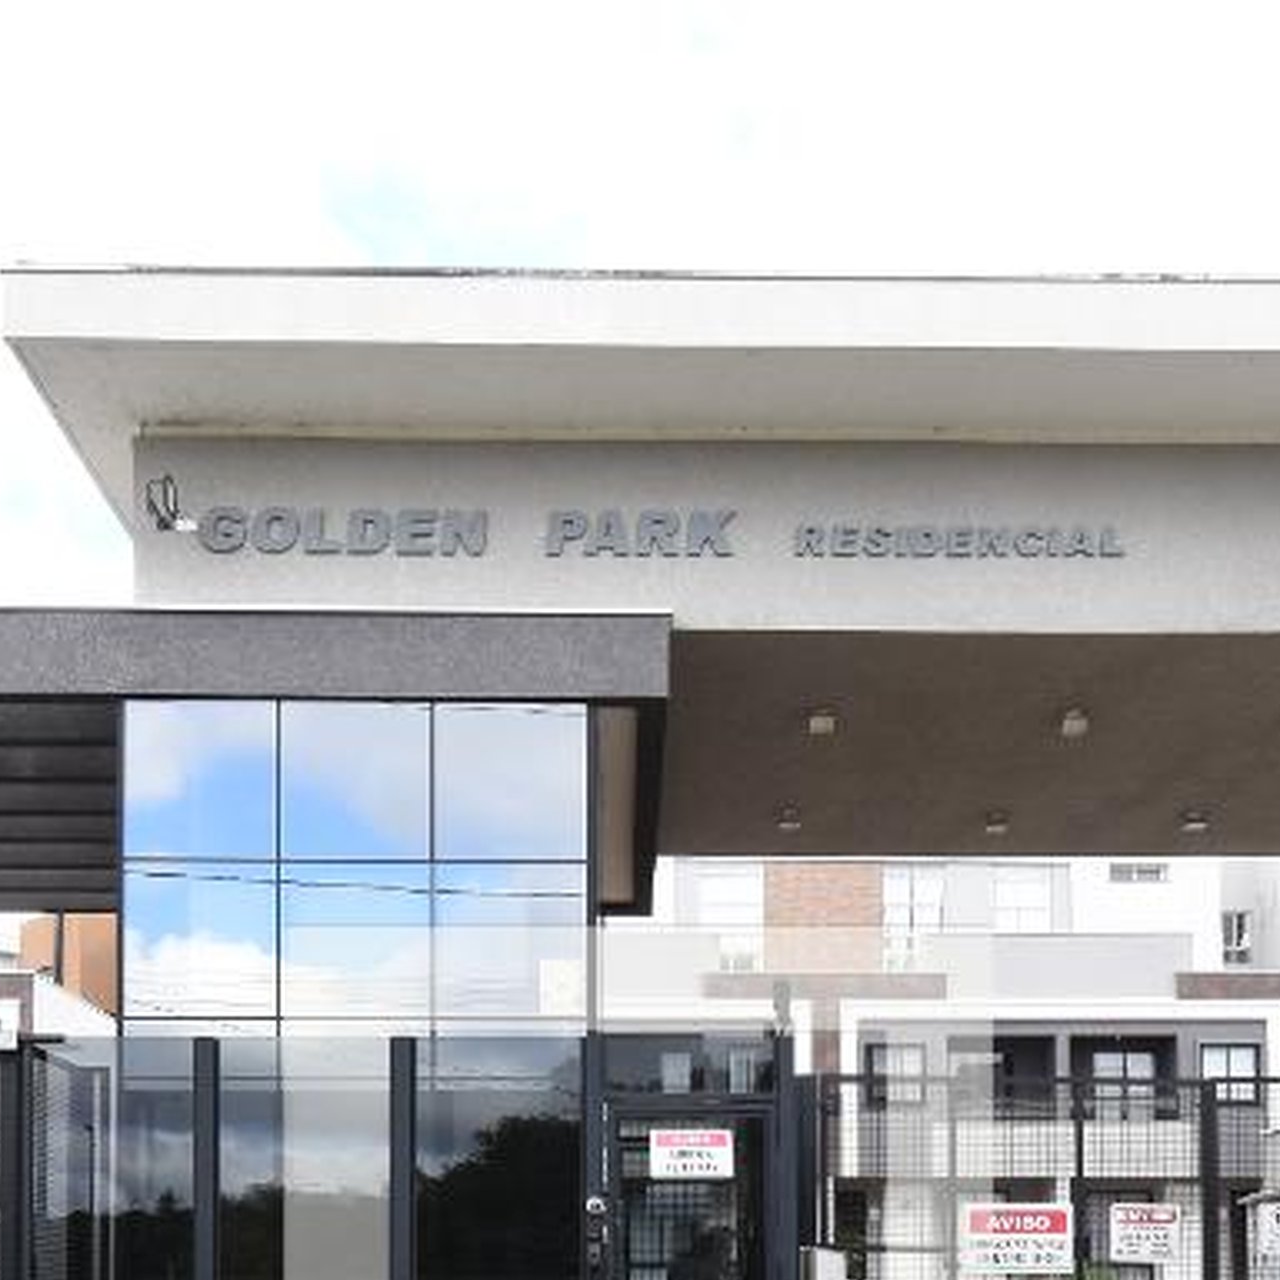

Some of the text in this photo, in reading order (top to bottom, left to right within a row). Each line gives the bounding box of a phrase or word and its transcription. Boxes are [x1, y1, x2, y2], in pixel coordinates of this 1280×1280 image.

[198, 506, 1125, 558] GOLDEN PARK RESIDENCIAL
[985, 1214, 1052, 1232] AVISO
